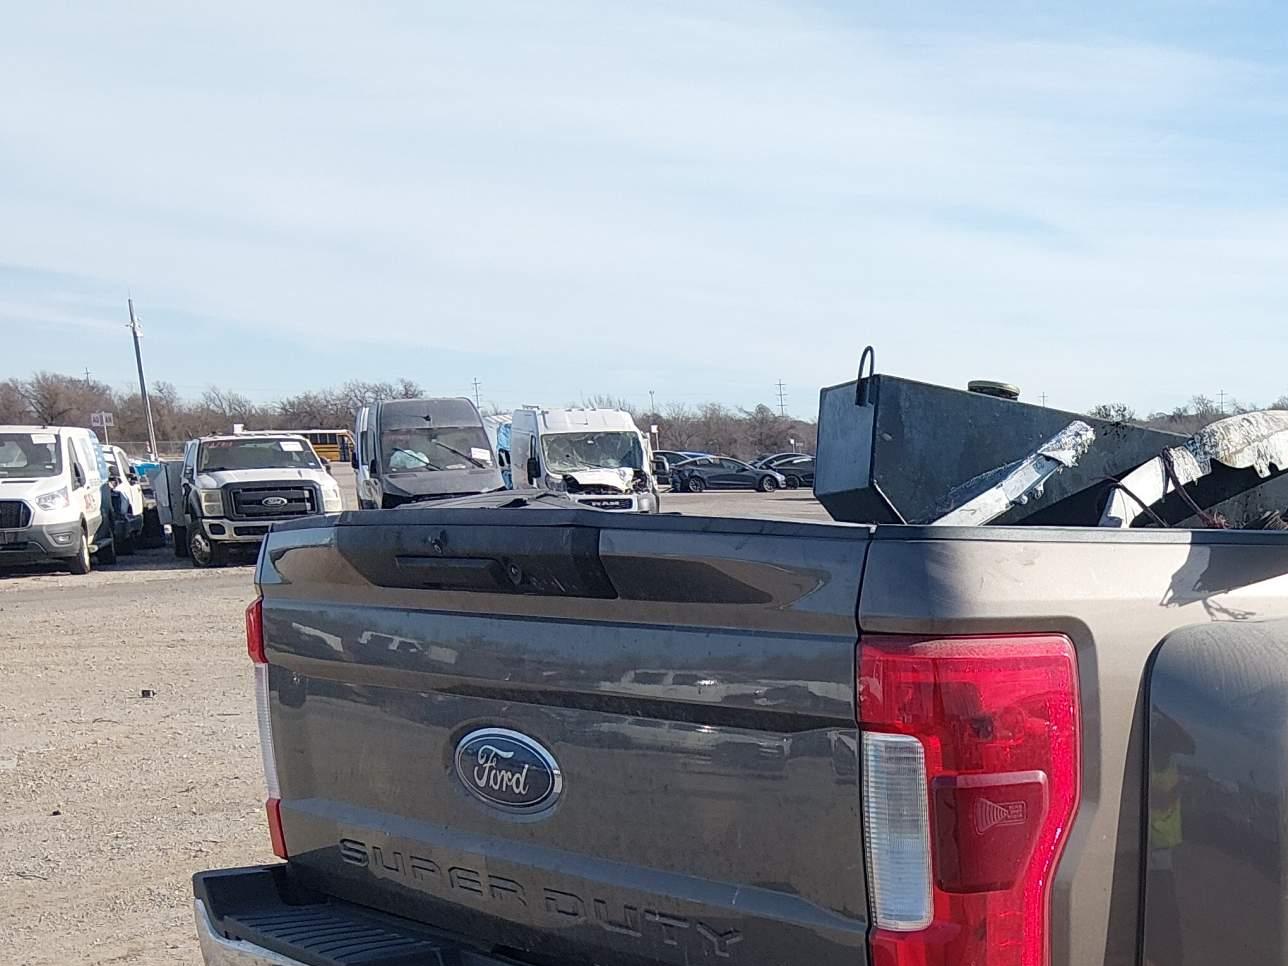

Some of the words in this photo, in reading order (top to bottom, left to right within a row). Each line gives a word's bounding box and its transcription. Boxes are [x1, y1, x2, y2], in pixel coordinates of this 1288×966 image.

[473, 744, 530, 796] Ford
[338, 836, 529, 908] SUPER
[543, 887, 745, 959] DUTY
